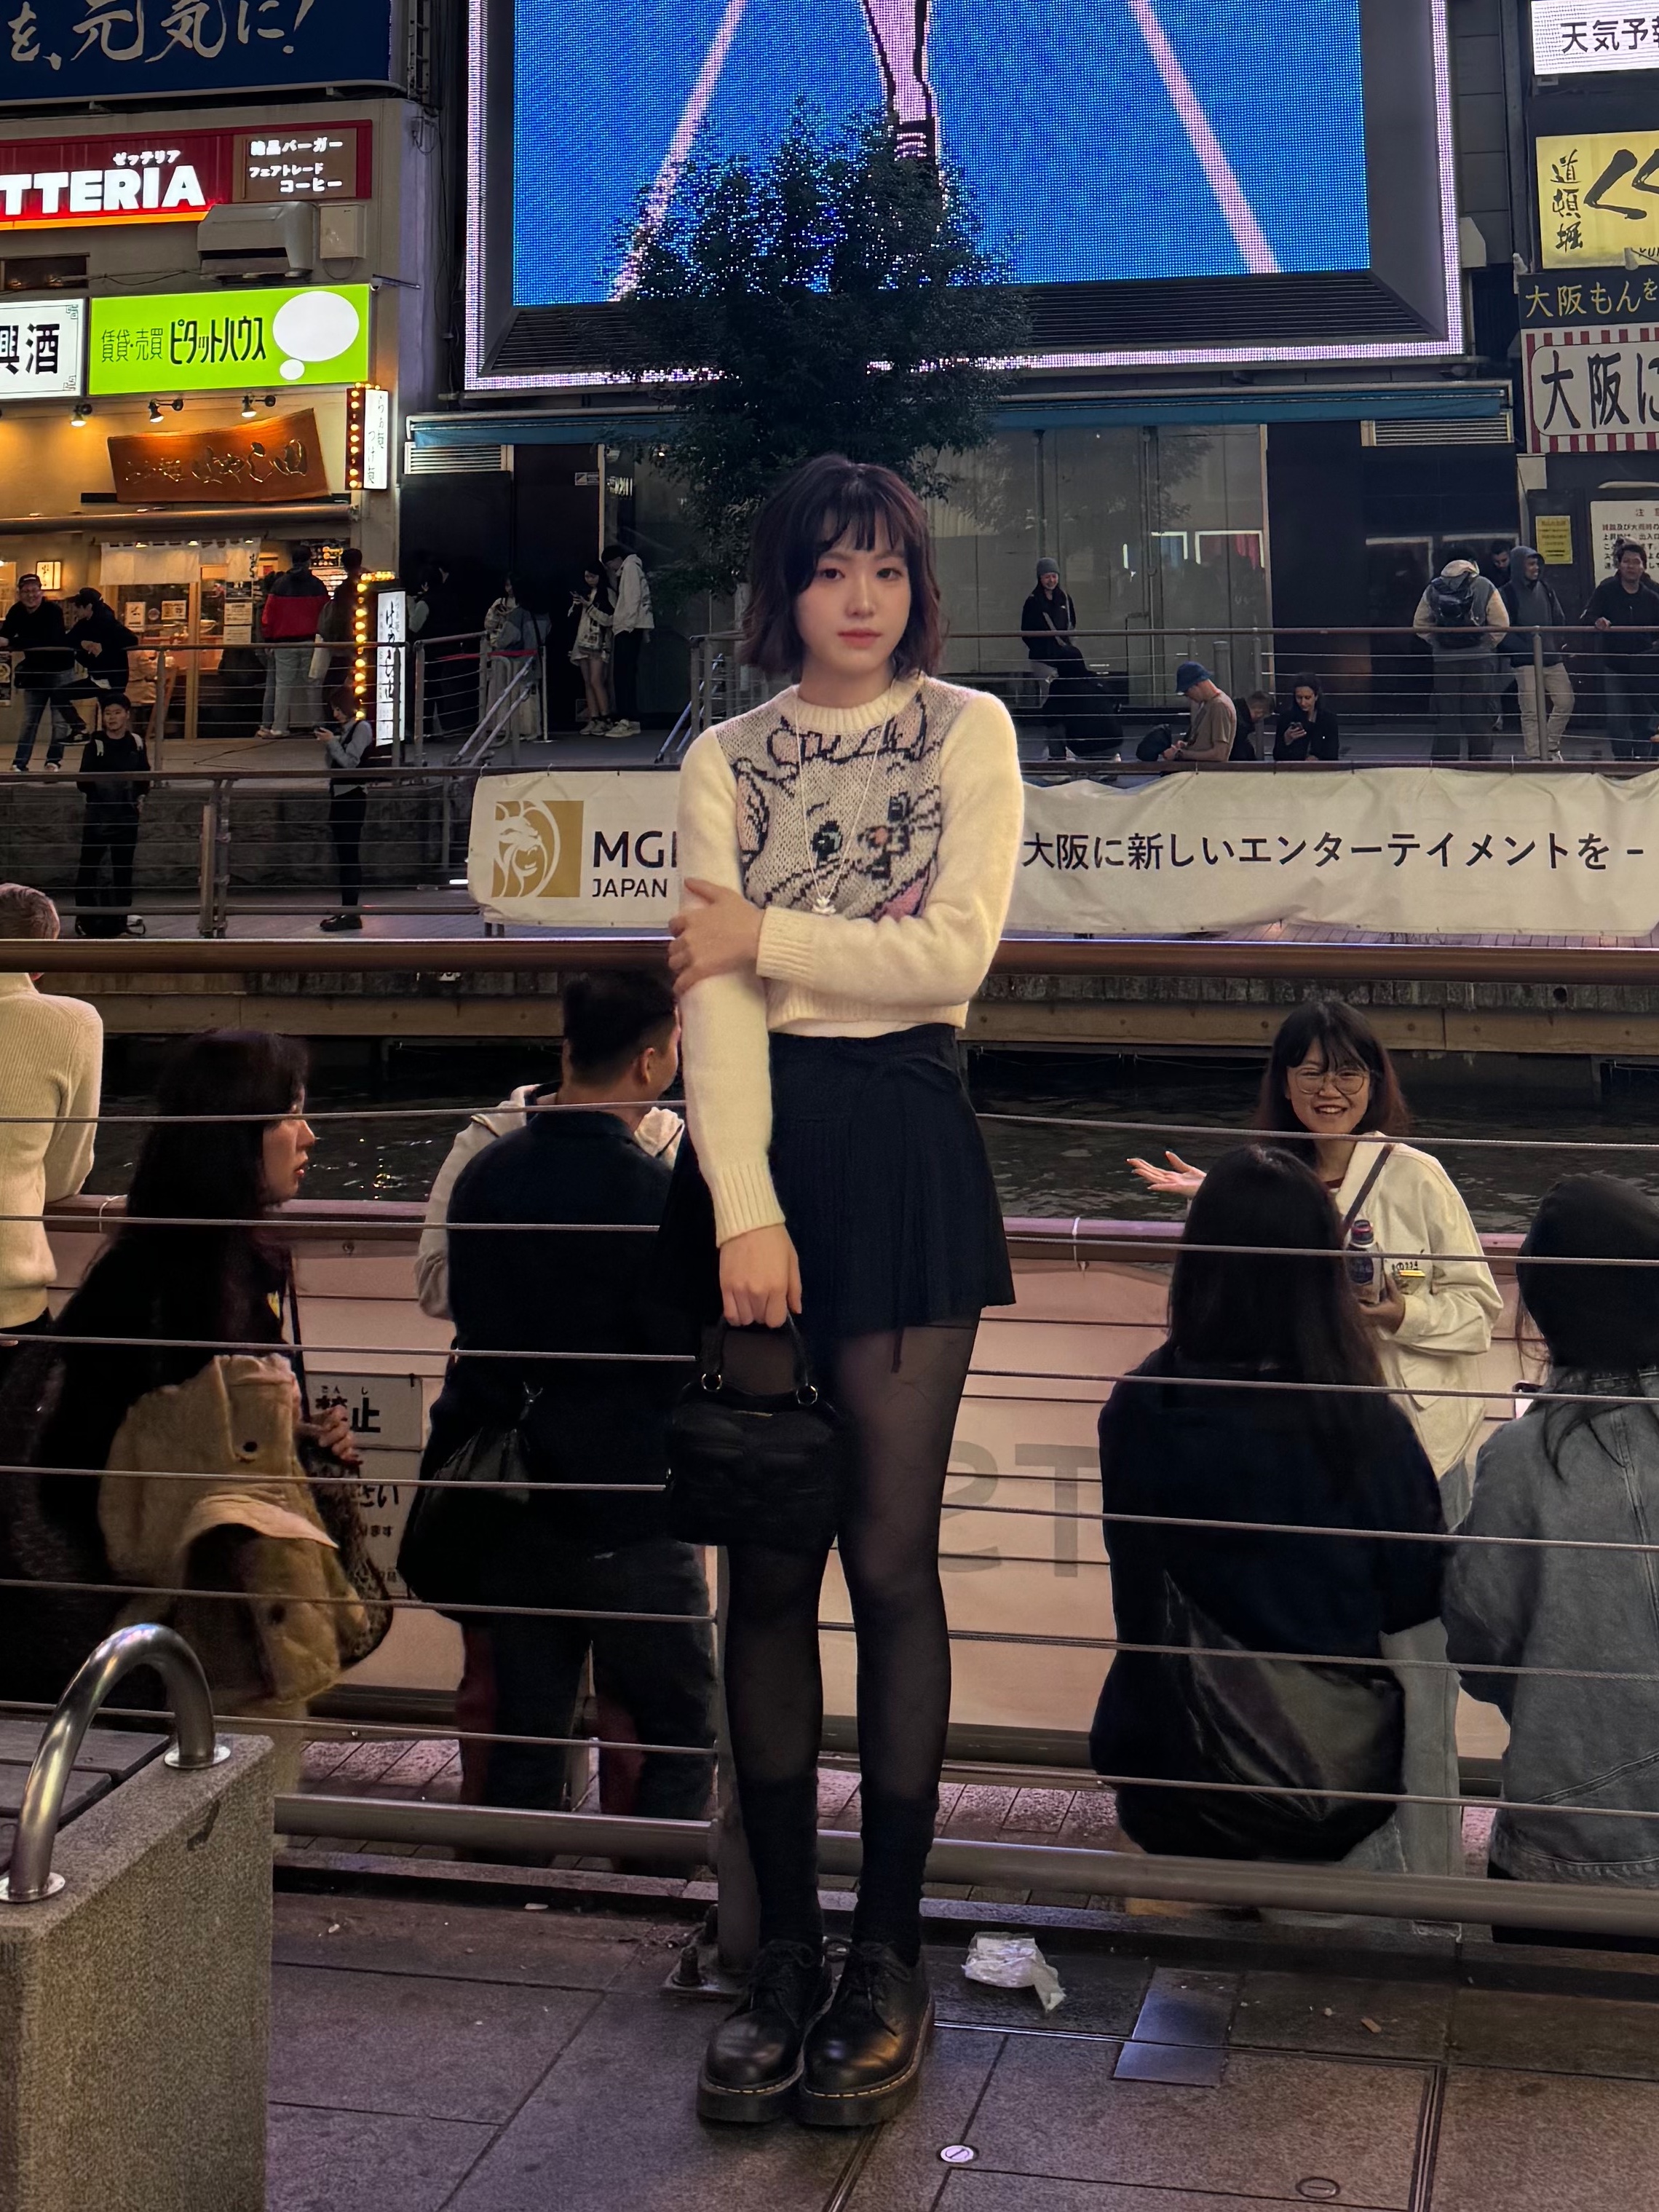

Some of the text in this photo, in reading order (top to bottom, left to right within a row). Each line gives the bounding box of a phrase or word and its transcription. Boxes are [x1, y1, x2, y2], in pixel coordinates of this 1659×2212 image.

[1560, 16, 1659, 53] 天気予
[249, 162, 324, 178] フェアトレード
[280, 177, 343, 193] コーヒー
[0, 165, 206, 216] TTERIA
[1550, 149, 1584, 253] 道頓堀
[101, 315, 266, 366] 賃貸・売買 ピタットハウス
[593, 830, 677, 868] MG
[1021, 832, 1610, 871] 大阪に新しいエンターテイメントを
[592, 877, 668, 898] JAPAN
